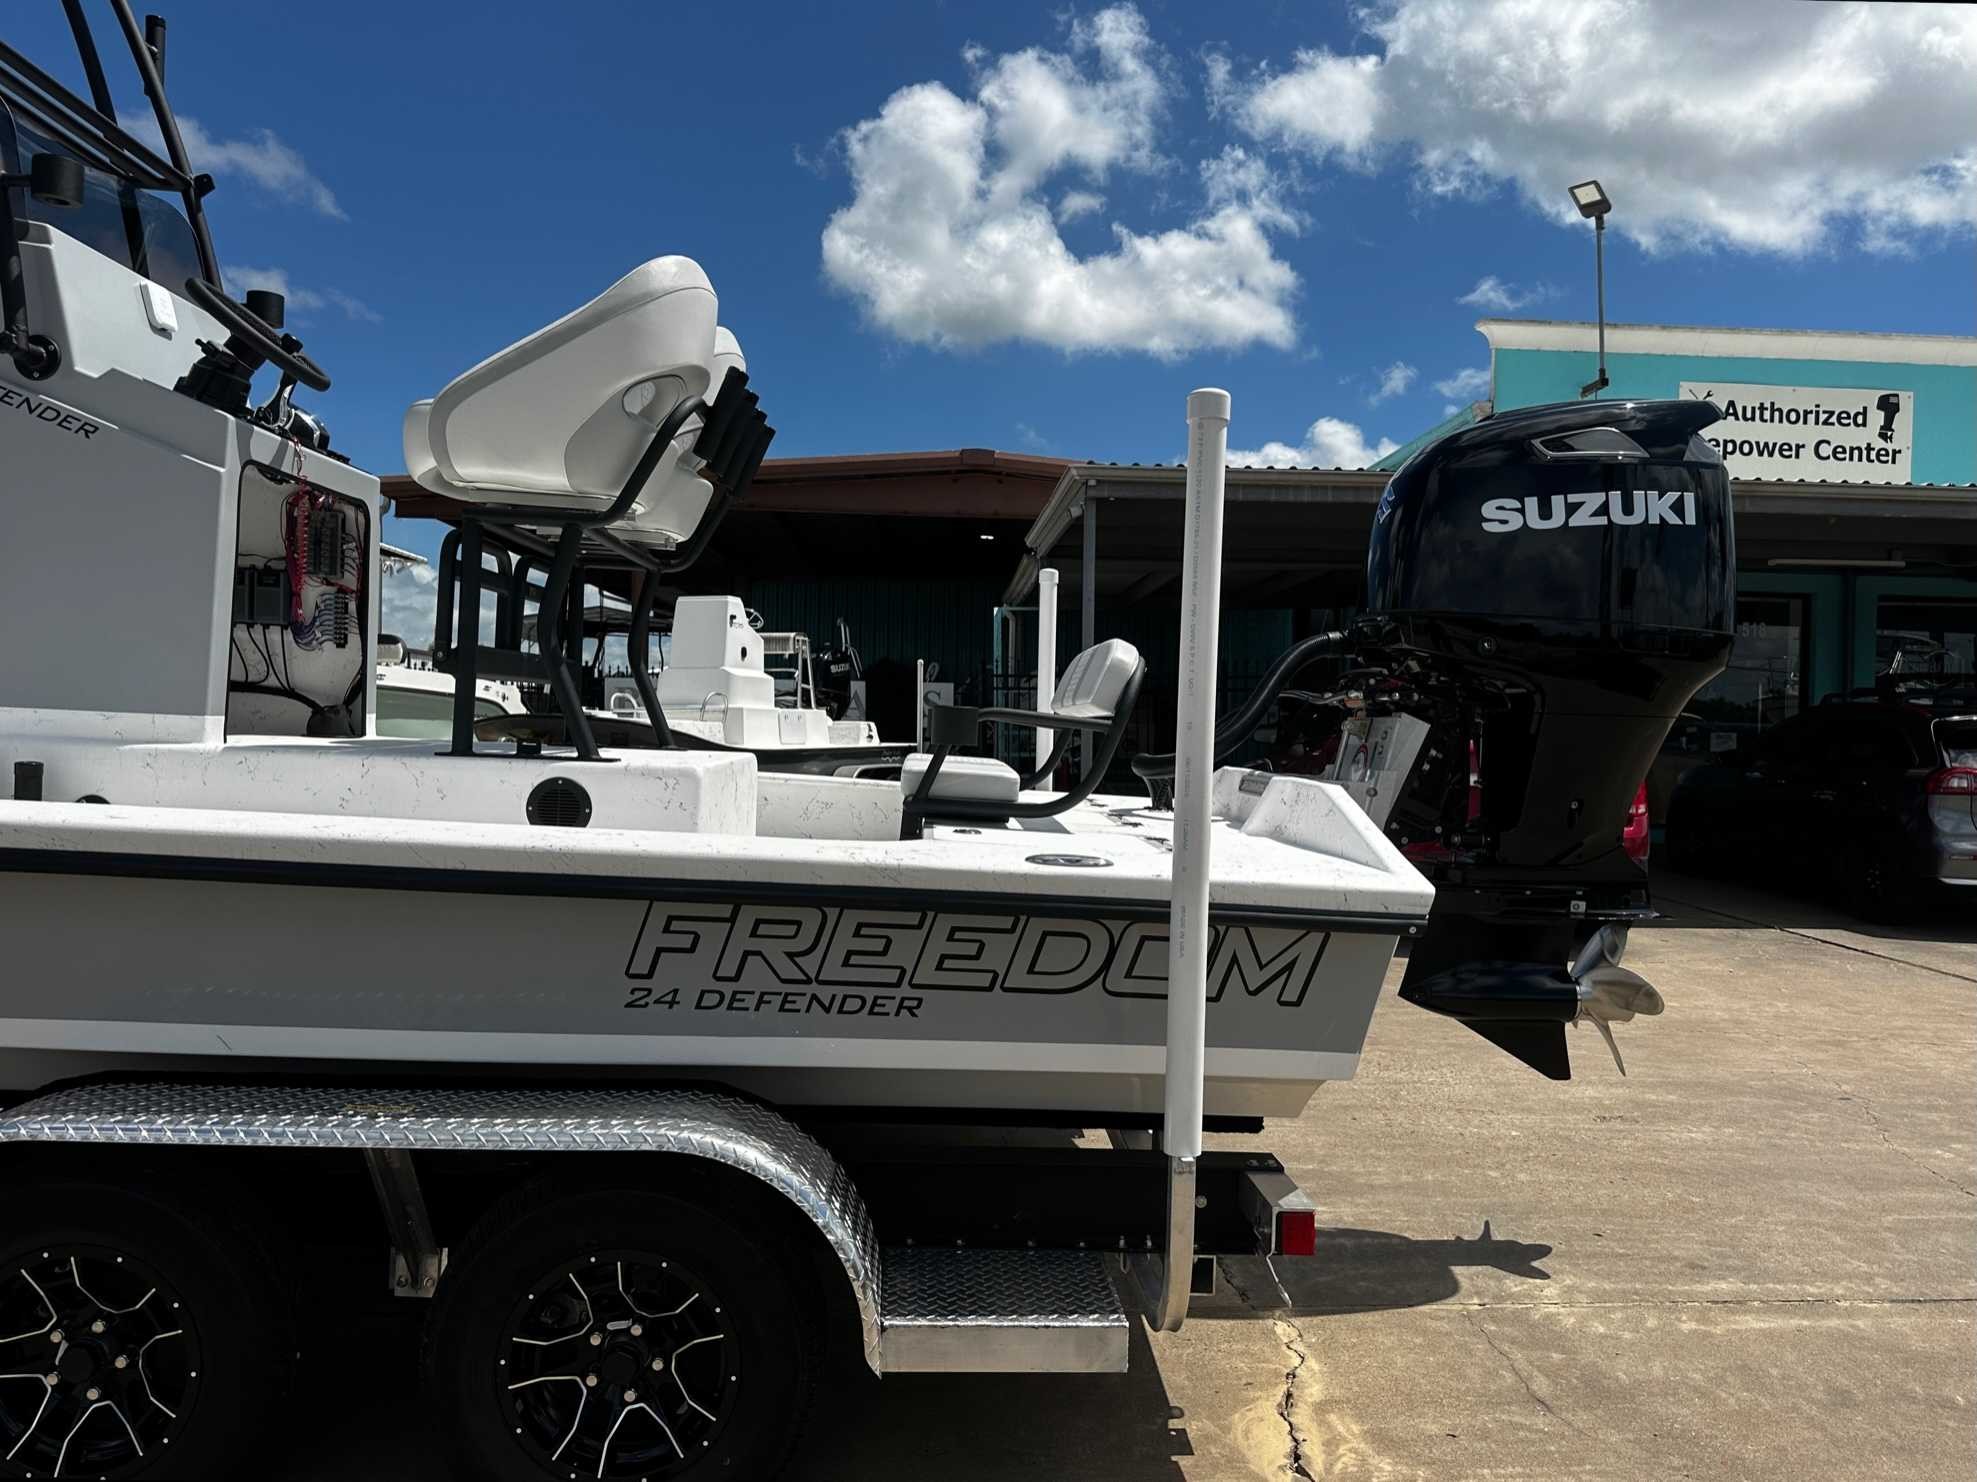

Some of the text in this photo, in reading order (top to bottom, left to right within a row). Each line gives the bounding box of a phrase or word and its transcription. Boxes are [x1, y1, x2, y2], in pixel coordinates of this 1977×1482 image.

[1723, 400, 1868, 428] Authorized
[1706, 437, 1902, 465] epower Center
[1480, 490, 1697, 533] SUZUKI
[624, 901, 1331, 1007] FREEDOM
[624, 986, 924, 1018] 24 DEFENDER
